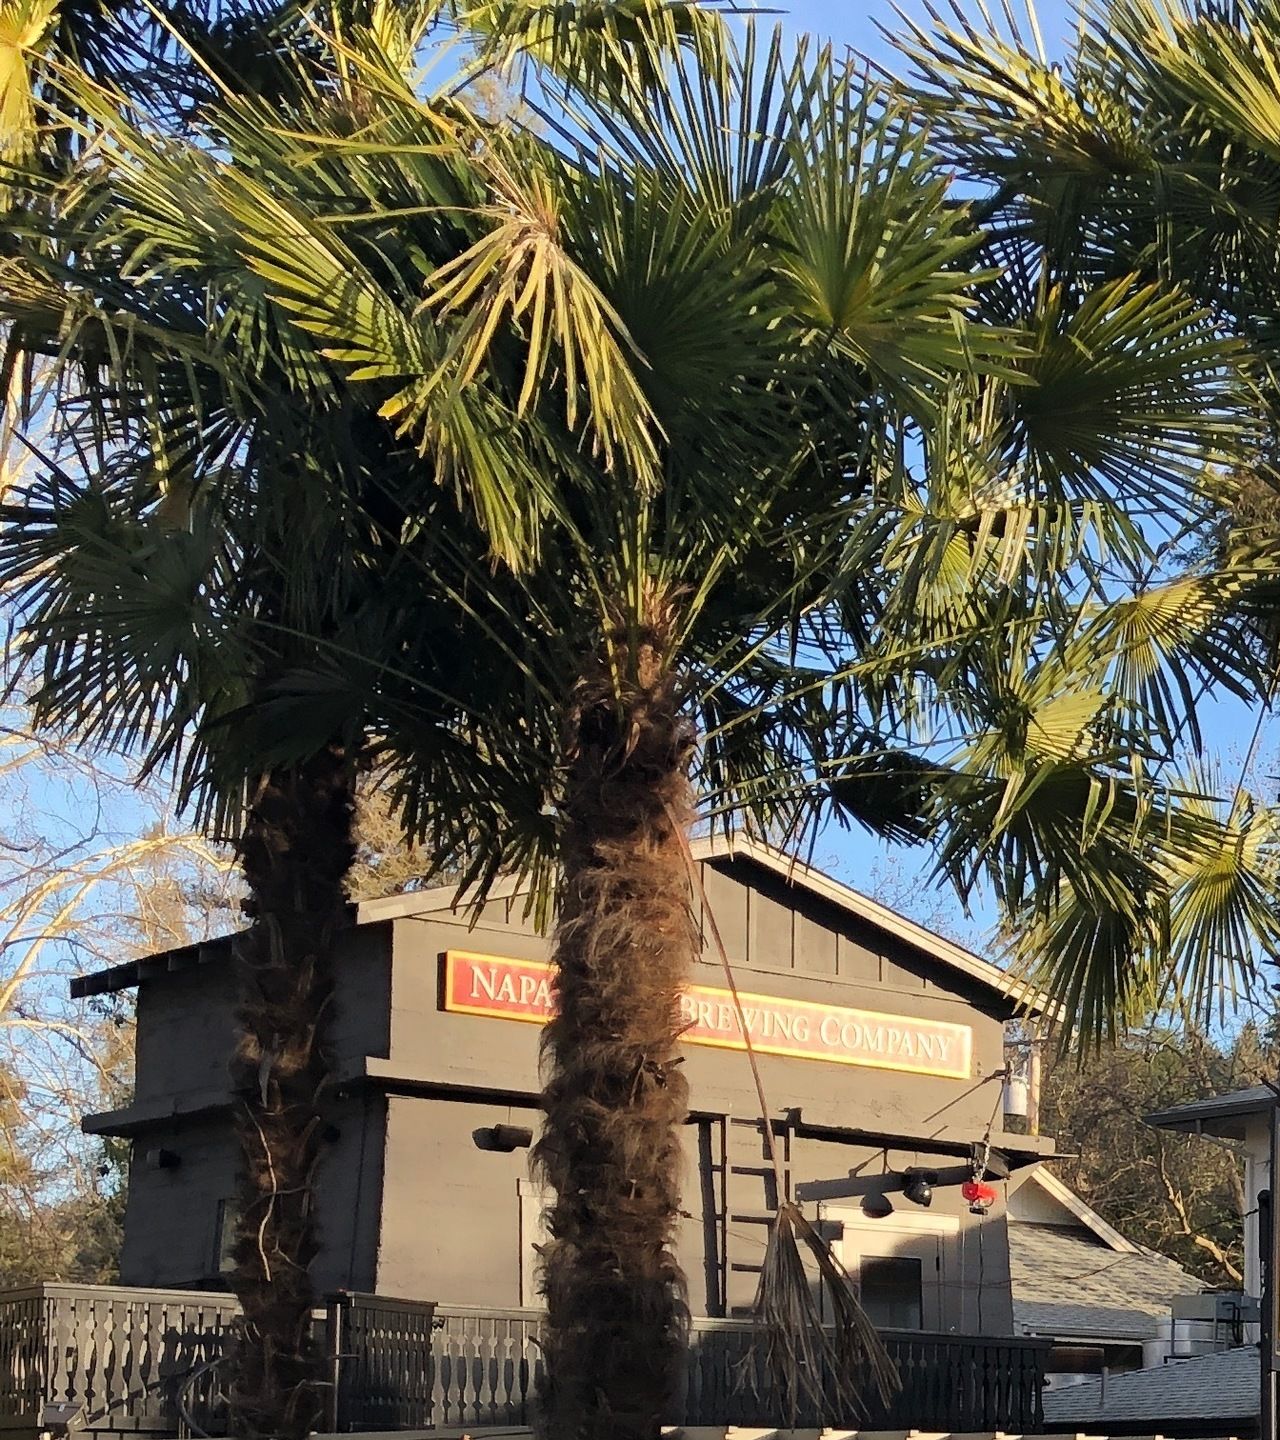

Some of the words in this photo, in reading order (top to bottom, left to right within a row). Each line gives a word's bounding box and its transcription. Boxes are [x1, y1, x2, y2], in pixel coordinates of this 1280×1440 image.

[469, 965, 555, 1007] NAPA
[679, 994, 810, 1043] BREWING
[820, 1015, 954, 1063] COMPANY
